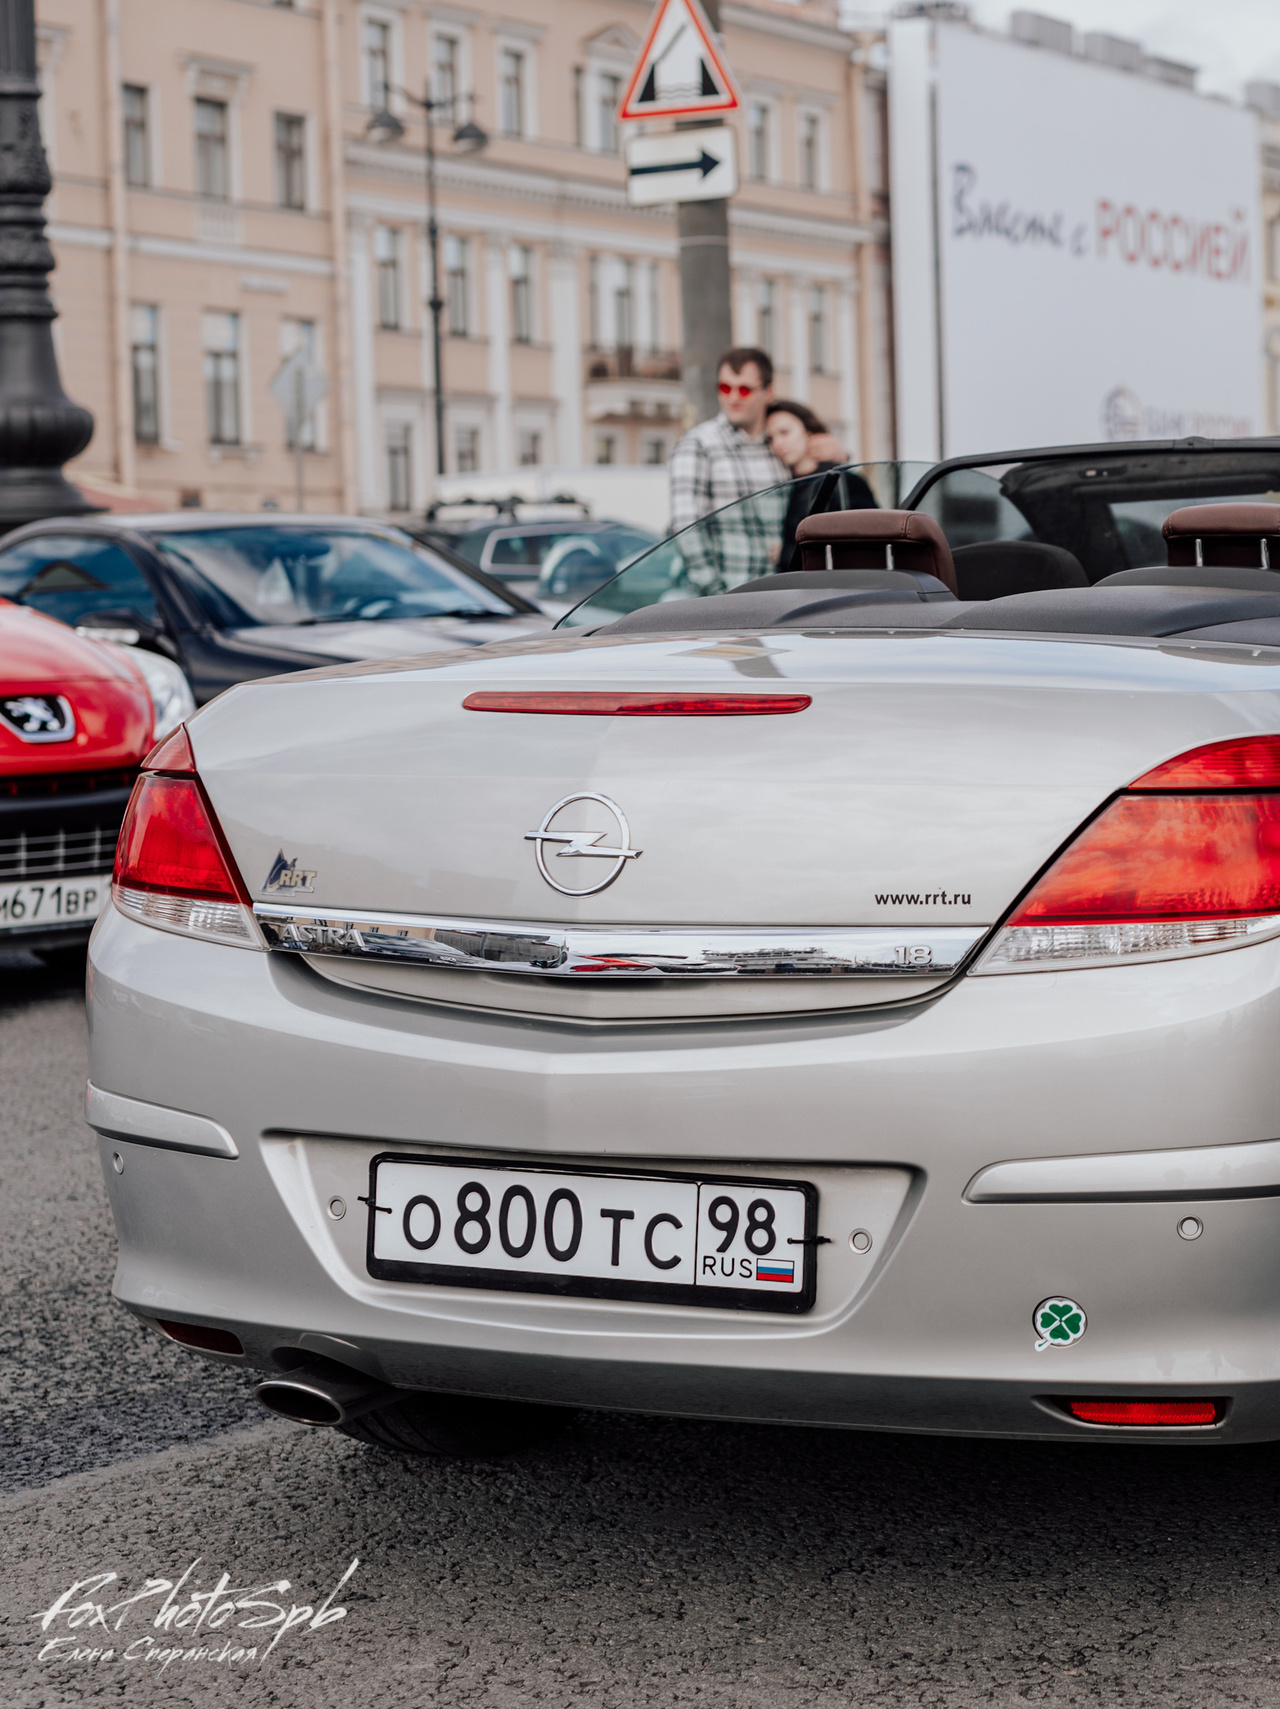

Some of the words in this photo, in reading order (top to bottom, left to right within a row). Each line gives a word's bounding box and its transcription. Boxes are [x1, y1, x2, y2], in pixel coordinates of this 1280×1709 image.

[1095, 197, 1252, 285] РОССИЕЙ
[874, 890, 972, 905] www.rrt.ru
[282, 923, 366, 948] ASTRA
[707, 1195, 777, 1256] 98
[702, 1255, 754, 1280] RUS
